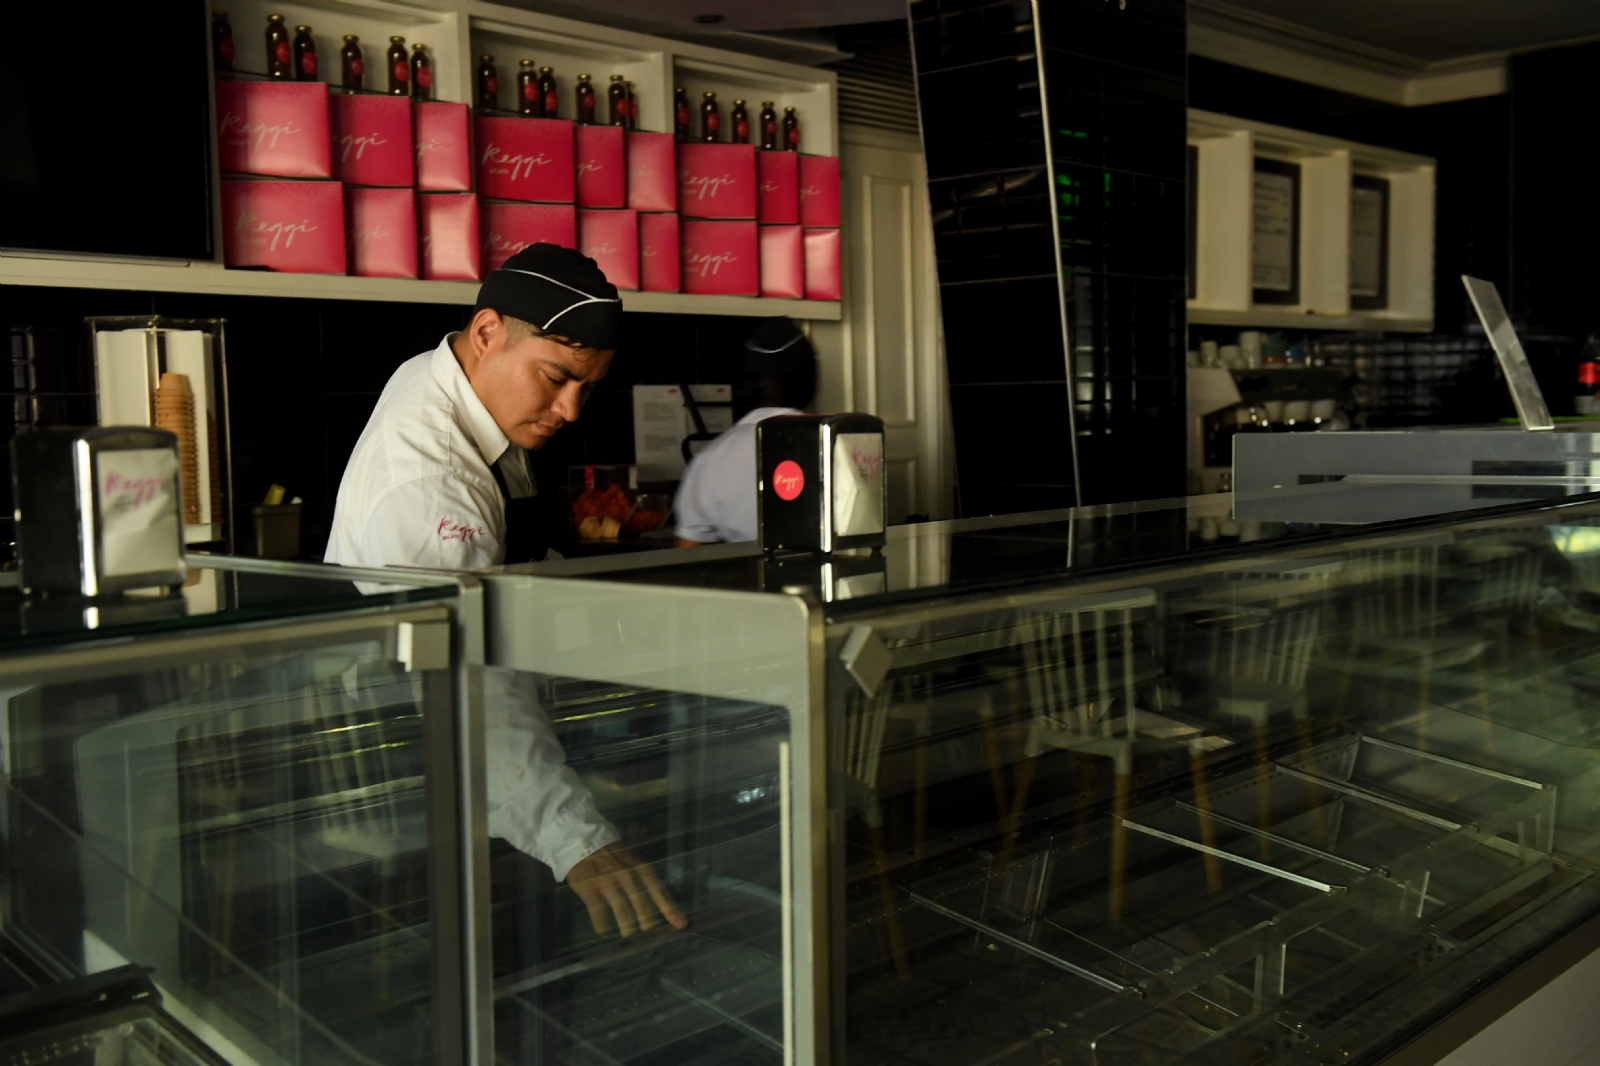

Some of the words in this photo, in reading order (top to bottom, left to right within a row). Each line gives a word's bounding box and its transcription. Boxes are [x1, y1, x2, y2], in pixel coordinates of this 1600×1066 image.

[219, 111, 302, 153] Reggi
[332, 132, 388, 163] eggi
[482, 143, 552, 182] Reggi
[235, 211, 318, 252] Reggi
[775, 474, 803, 491] Reggi
[438, 517, 487, 543] Reggi
